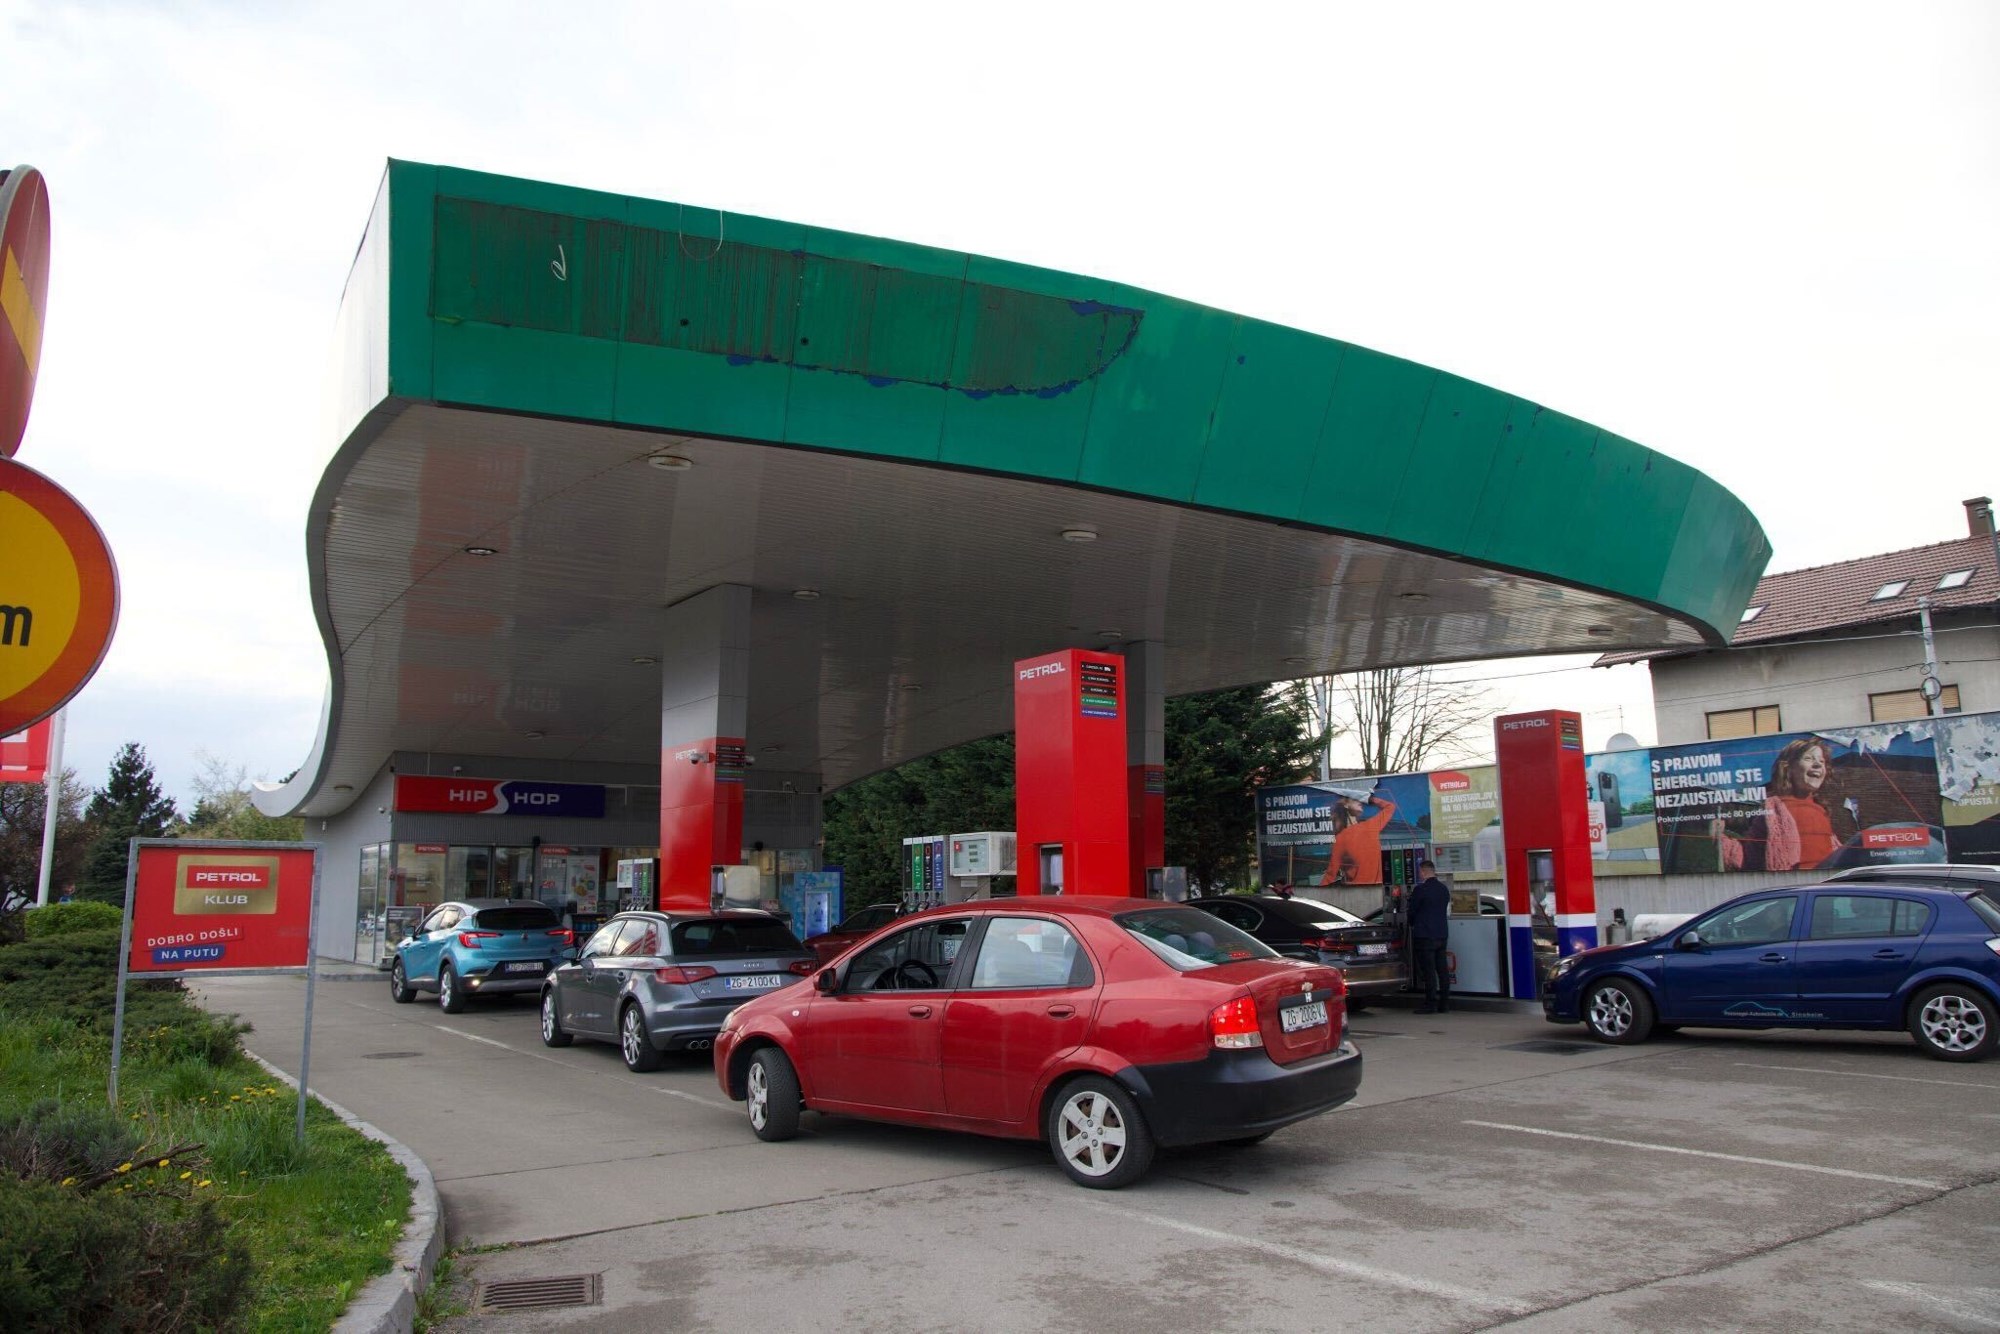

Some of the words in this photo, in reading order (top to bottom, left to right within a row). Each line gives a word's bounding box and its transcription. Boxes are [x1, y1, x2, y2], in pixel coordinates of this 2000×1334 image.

[1020, 662, 1066, 680] PETROL
[1503, 719, 1549, 730] PETROL
[1651, 760, 1661, 773] S
[1664, 753, 1722, 771] PRAVOM
[1653, 771, 1732, 791] ENERGIJOM
[1735, 768, 1763, 783] STE
[449, 790, 488, 801] HIP
[1266, 797, 1271, 807] S
[1273, 794, 1308, 807] PRAVOM
[1655, 787, 1767, 808] NEZAUSTAVLJIVI
[1266, 808, 1313, 820] ENERGIJOM
[1315, 807, 1331, 817] STE
[1657, 814, 1701, 823] Pokrećemo
[1717, 811, 1732, 820] već
[1267, 821, 1334, 835] NEZAUSTAVLJIVI
[196, 872, 262, 882] PETROL
[204, 895, 248, 904] KLUB
[147, 933, 194, 947] DOBRO
[200, 927, 238, 941] DOŠLI
[161, 950, 179, 959] NA
[184, 948, 219, 958] PUTU
[731, 976, 742, 988] ZG
[1286, 1010, 1297, 1026] ZG
